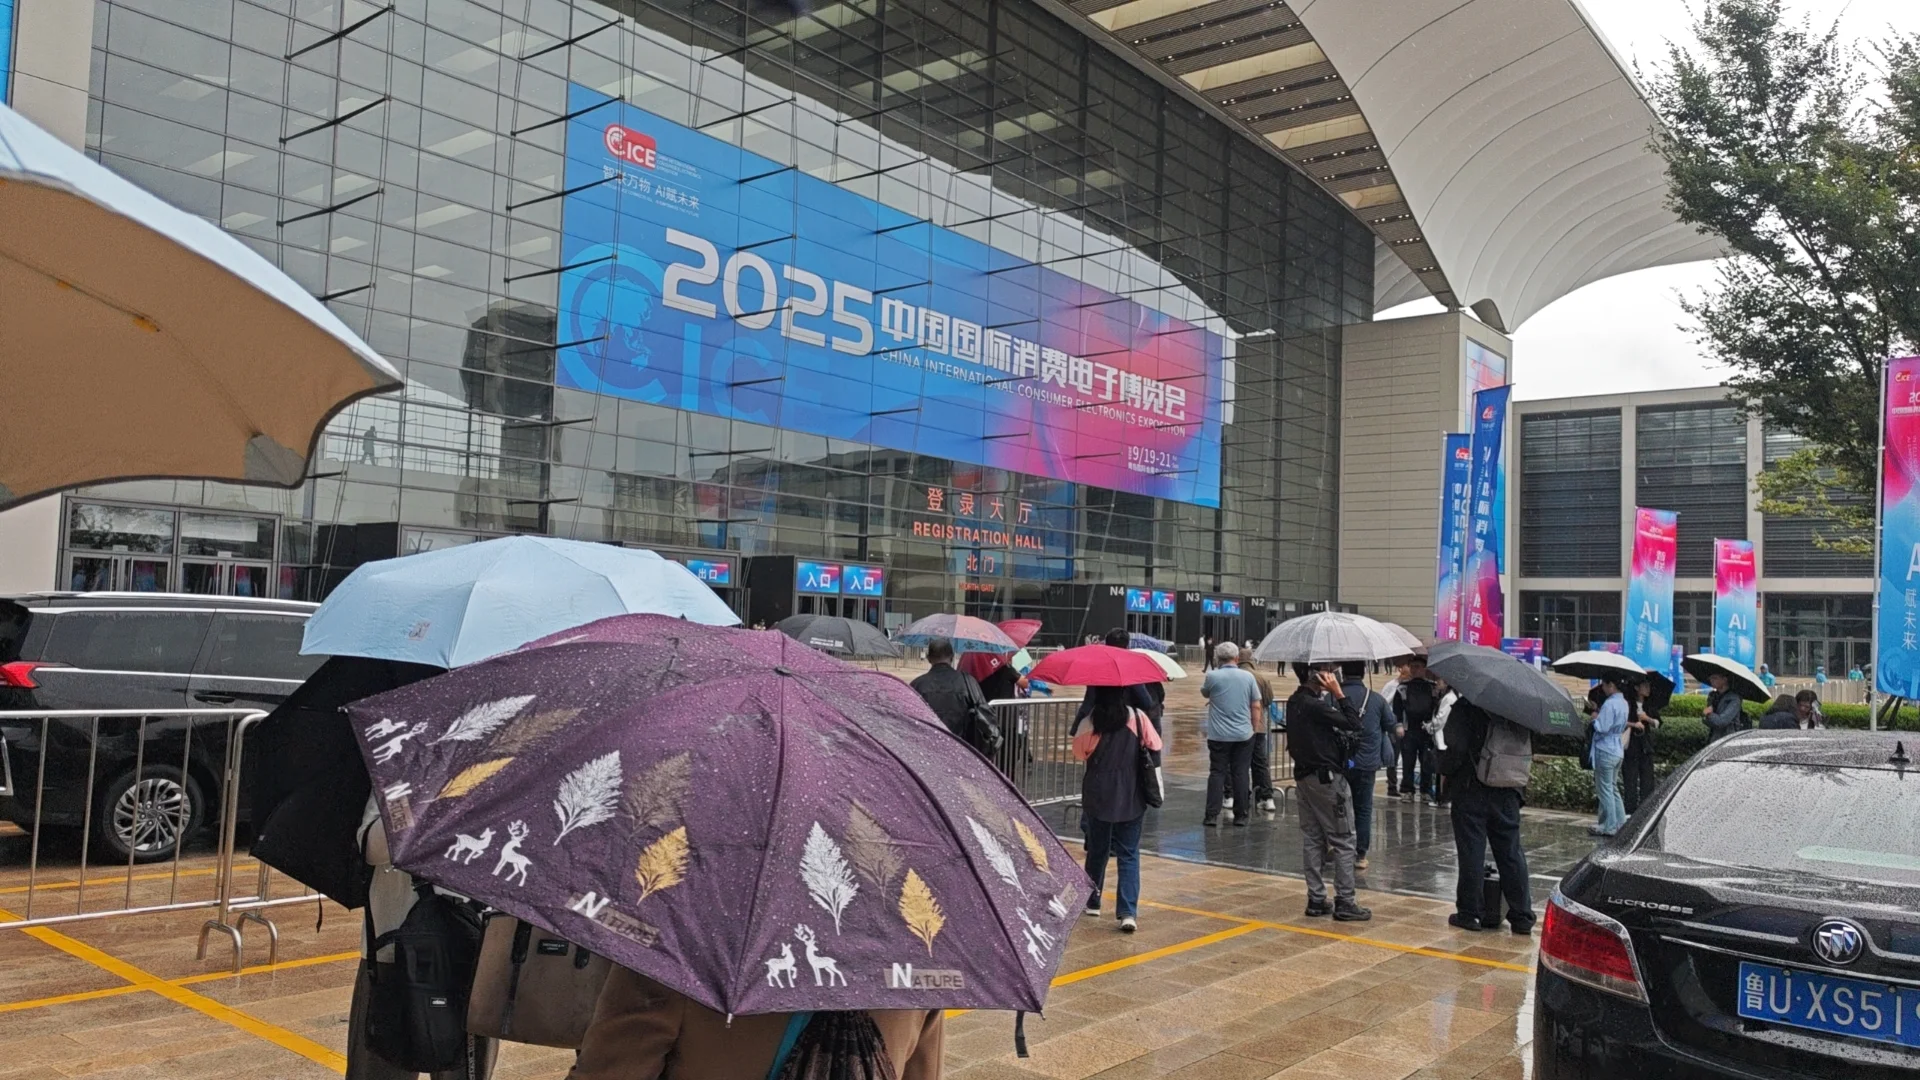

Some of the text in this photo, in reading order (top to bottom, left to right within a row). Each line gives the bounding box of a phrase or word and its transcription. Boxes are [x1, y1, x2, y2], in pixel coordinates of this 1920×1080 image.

[606, 126, 656, 168] CICE
[662, 227, 874, 356] 2025
[881, 297, 1186, 421] 中国国际消费电子博览会
[880, 346, 1186, 437] CHINA INTERNATIONAL CONSUMER ELECTRONICS EXPOSITION
[1132, 445, 1171, 468] 9/19-21
[927, 487, 1033, 524] 登录大厅
[914, 521, 1044, 549] REGISTRATION HALL
[967, 554, 994, 573] 北门
[698, 568, 717, 580] 出口
[805, 571, 831, 589] 入口
[850, 575, 874, 591] 入口
[1110, 586, 1124, 596] N4
[1186, 592, 1200, 602] N3
[1131, 596, 1146, 608] 入口
[1156, 598, 1170, 609] 入口
[1251, 598, 1265, 607] N2
[1312, 602, 1324, 611] N1
[1640, 600, 1659, 624] AI
[1902, 588, 1917, 649] 赋未来
[1728, 613, 1747, 631] AI
[892, 962, 962, 988] NATURE
